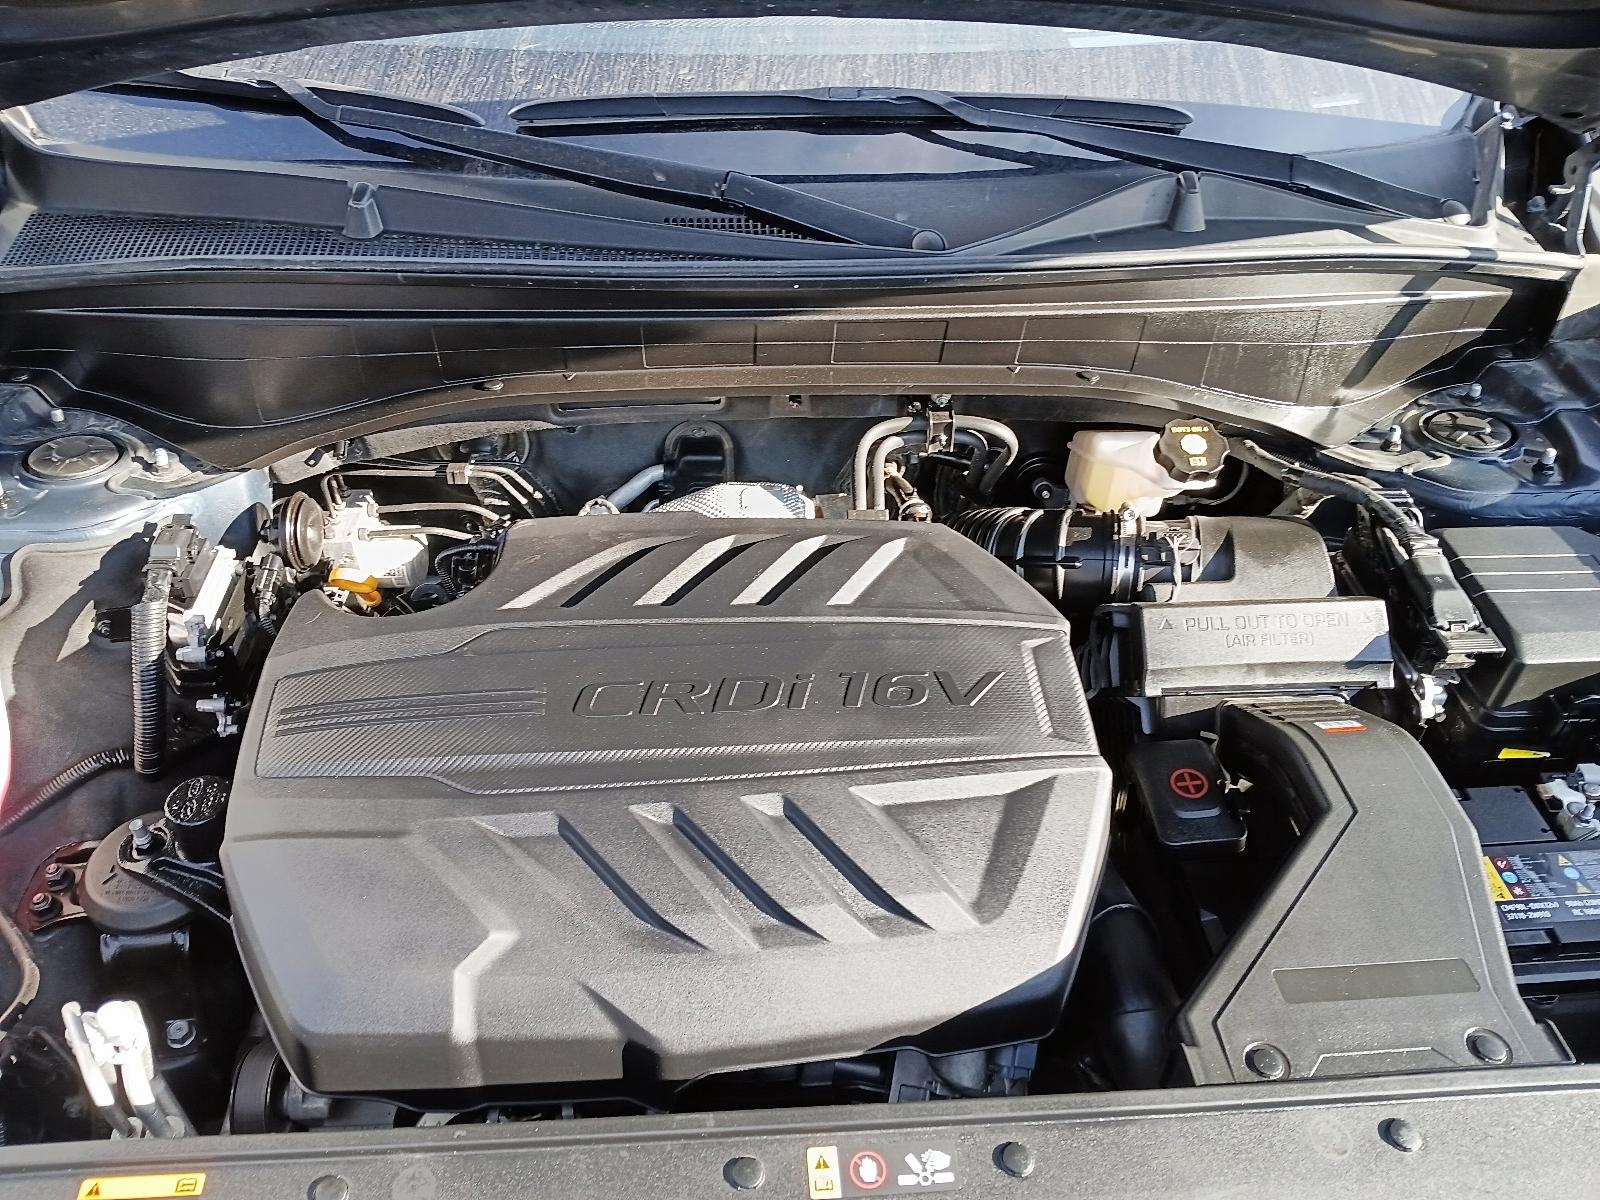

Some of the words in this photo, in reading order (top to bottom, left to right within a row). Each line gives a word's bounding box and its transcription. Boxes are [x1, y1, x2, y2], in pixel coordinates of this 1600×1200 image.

[1184, 617, 1230, 632] PULL
[1234, 615, 1269, 630] OUT
[1277, 613, 1297, 629] TO
[1303, 611, 1349, 628] OPEN
[1225, 633, 1257, 649] (AIR
[1260, 631, 1315, 647] FILTER)
[572, 673, 815, 718] CRDi
[839, 671, 1007, 710] 16V
